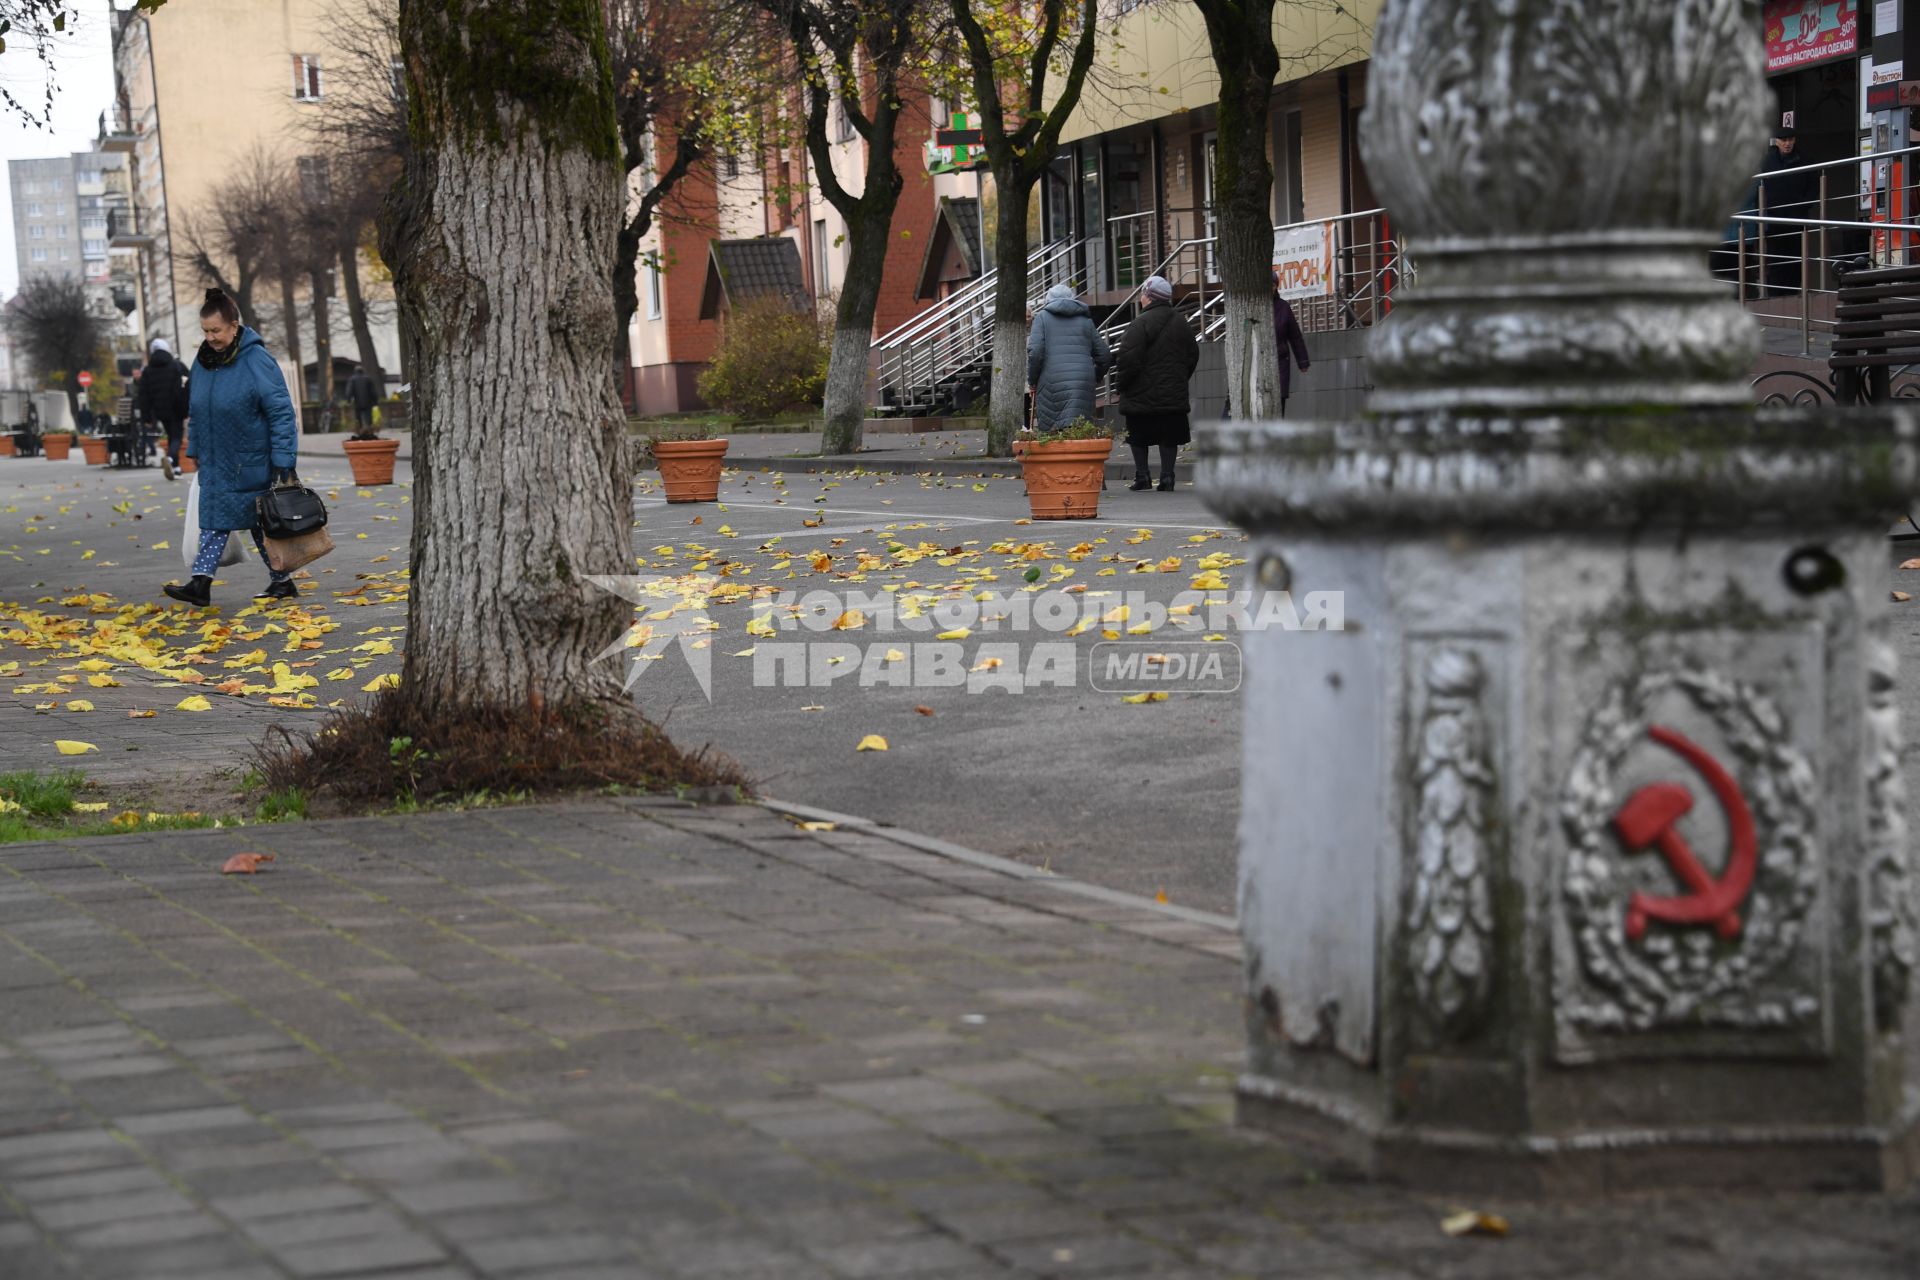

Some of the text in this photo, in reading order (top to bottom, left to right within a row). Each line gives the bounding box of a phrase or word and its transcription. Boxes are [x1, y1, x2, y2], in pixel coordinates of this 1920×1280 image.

[1768, 53, 1793, 68] МАГАЗИН
[1793, 45, 1827, 62] РАСПРОДАЖ
[1827, 38, 1854, 54] ОДЕЖДЫ
